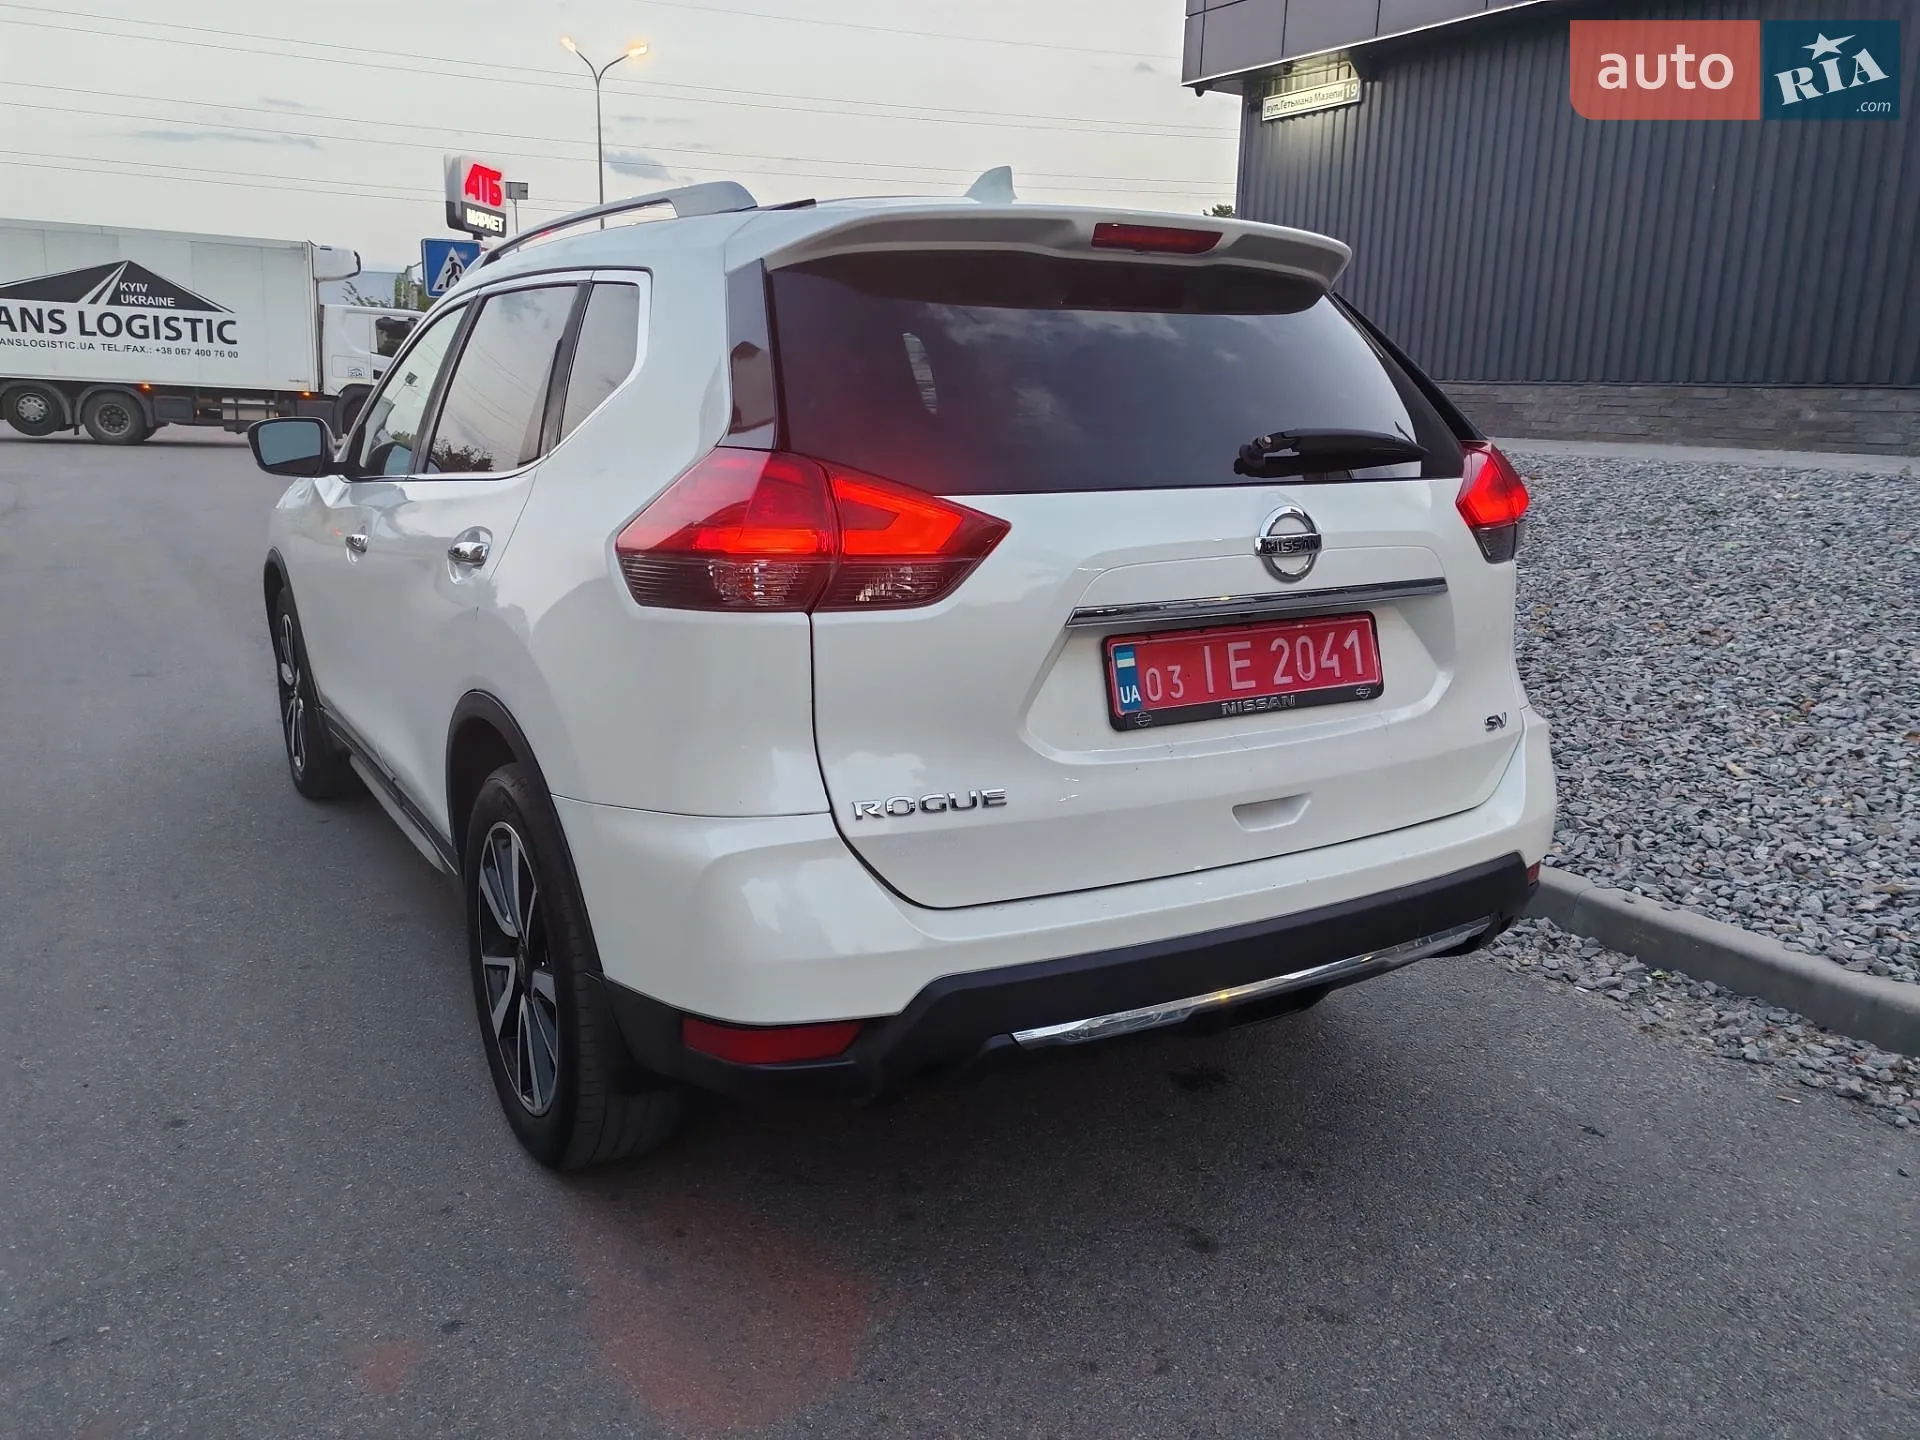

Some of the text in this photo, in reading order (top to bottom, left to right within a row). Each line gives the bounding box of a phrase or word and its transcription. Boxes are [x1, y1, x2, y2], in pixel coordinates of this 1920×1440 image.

[1345, 83, 1358, 98] 19
[465, 164, 502, 206] АТБ
[120, 281, 148, 293] KYIV
[121, 294, 175, 307] UKRAINE
[78, 310, 237, 345] LOGISTIC
[175, 347, 191, 356] 067
[194, 348, 211, 357] 400
[214, 349, 225, 358] 76
[228, 350, 238, 359] 00
[1261, 538, 1319, 553] NISSAN
[1120, 685, 1141, 704] UA
[1145, 664, 1184, 701] 03
[1270, 629, 1364, 686] 2041
[1221, 695, 1296, 715] NISSAN
[1484, 711, 1507, 732] SV
[852, 788, 1007, 821] ROGUE
